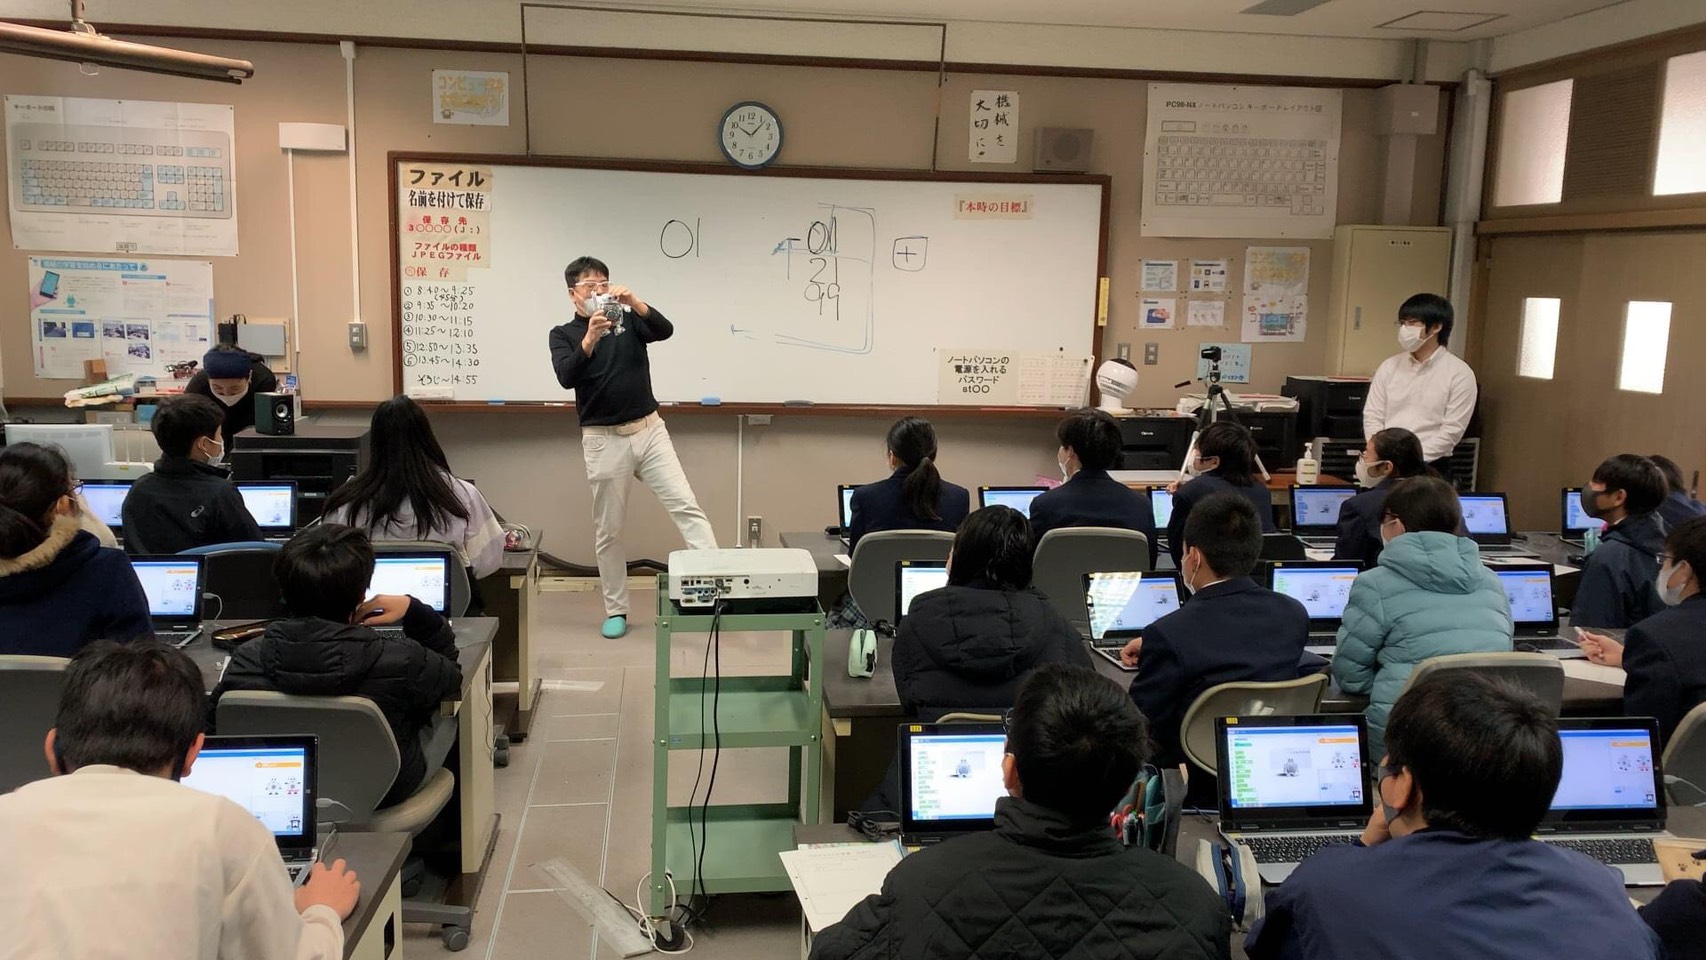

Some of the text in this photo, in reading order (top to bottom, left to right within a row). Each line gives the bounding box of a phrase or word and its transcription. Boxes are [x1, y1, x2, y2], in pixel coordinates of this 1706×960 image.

[410, 169, 485, 187] ファイル
[409, 190, 484, 209] 名前を付けて保存
[959, 200, 1027, 213] 『本時の目標』
[947, 355, 1010, 365] ノートパソコンの
[954, 364, 1007, 374] 電源を入れる
[958, 375, 1000, 384] パスワード
